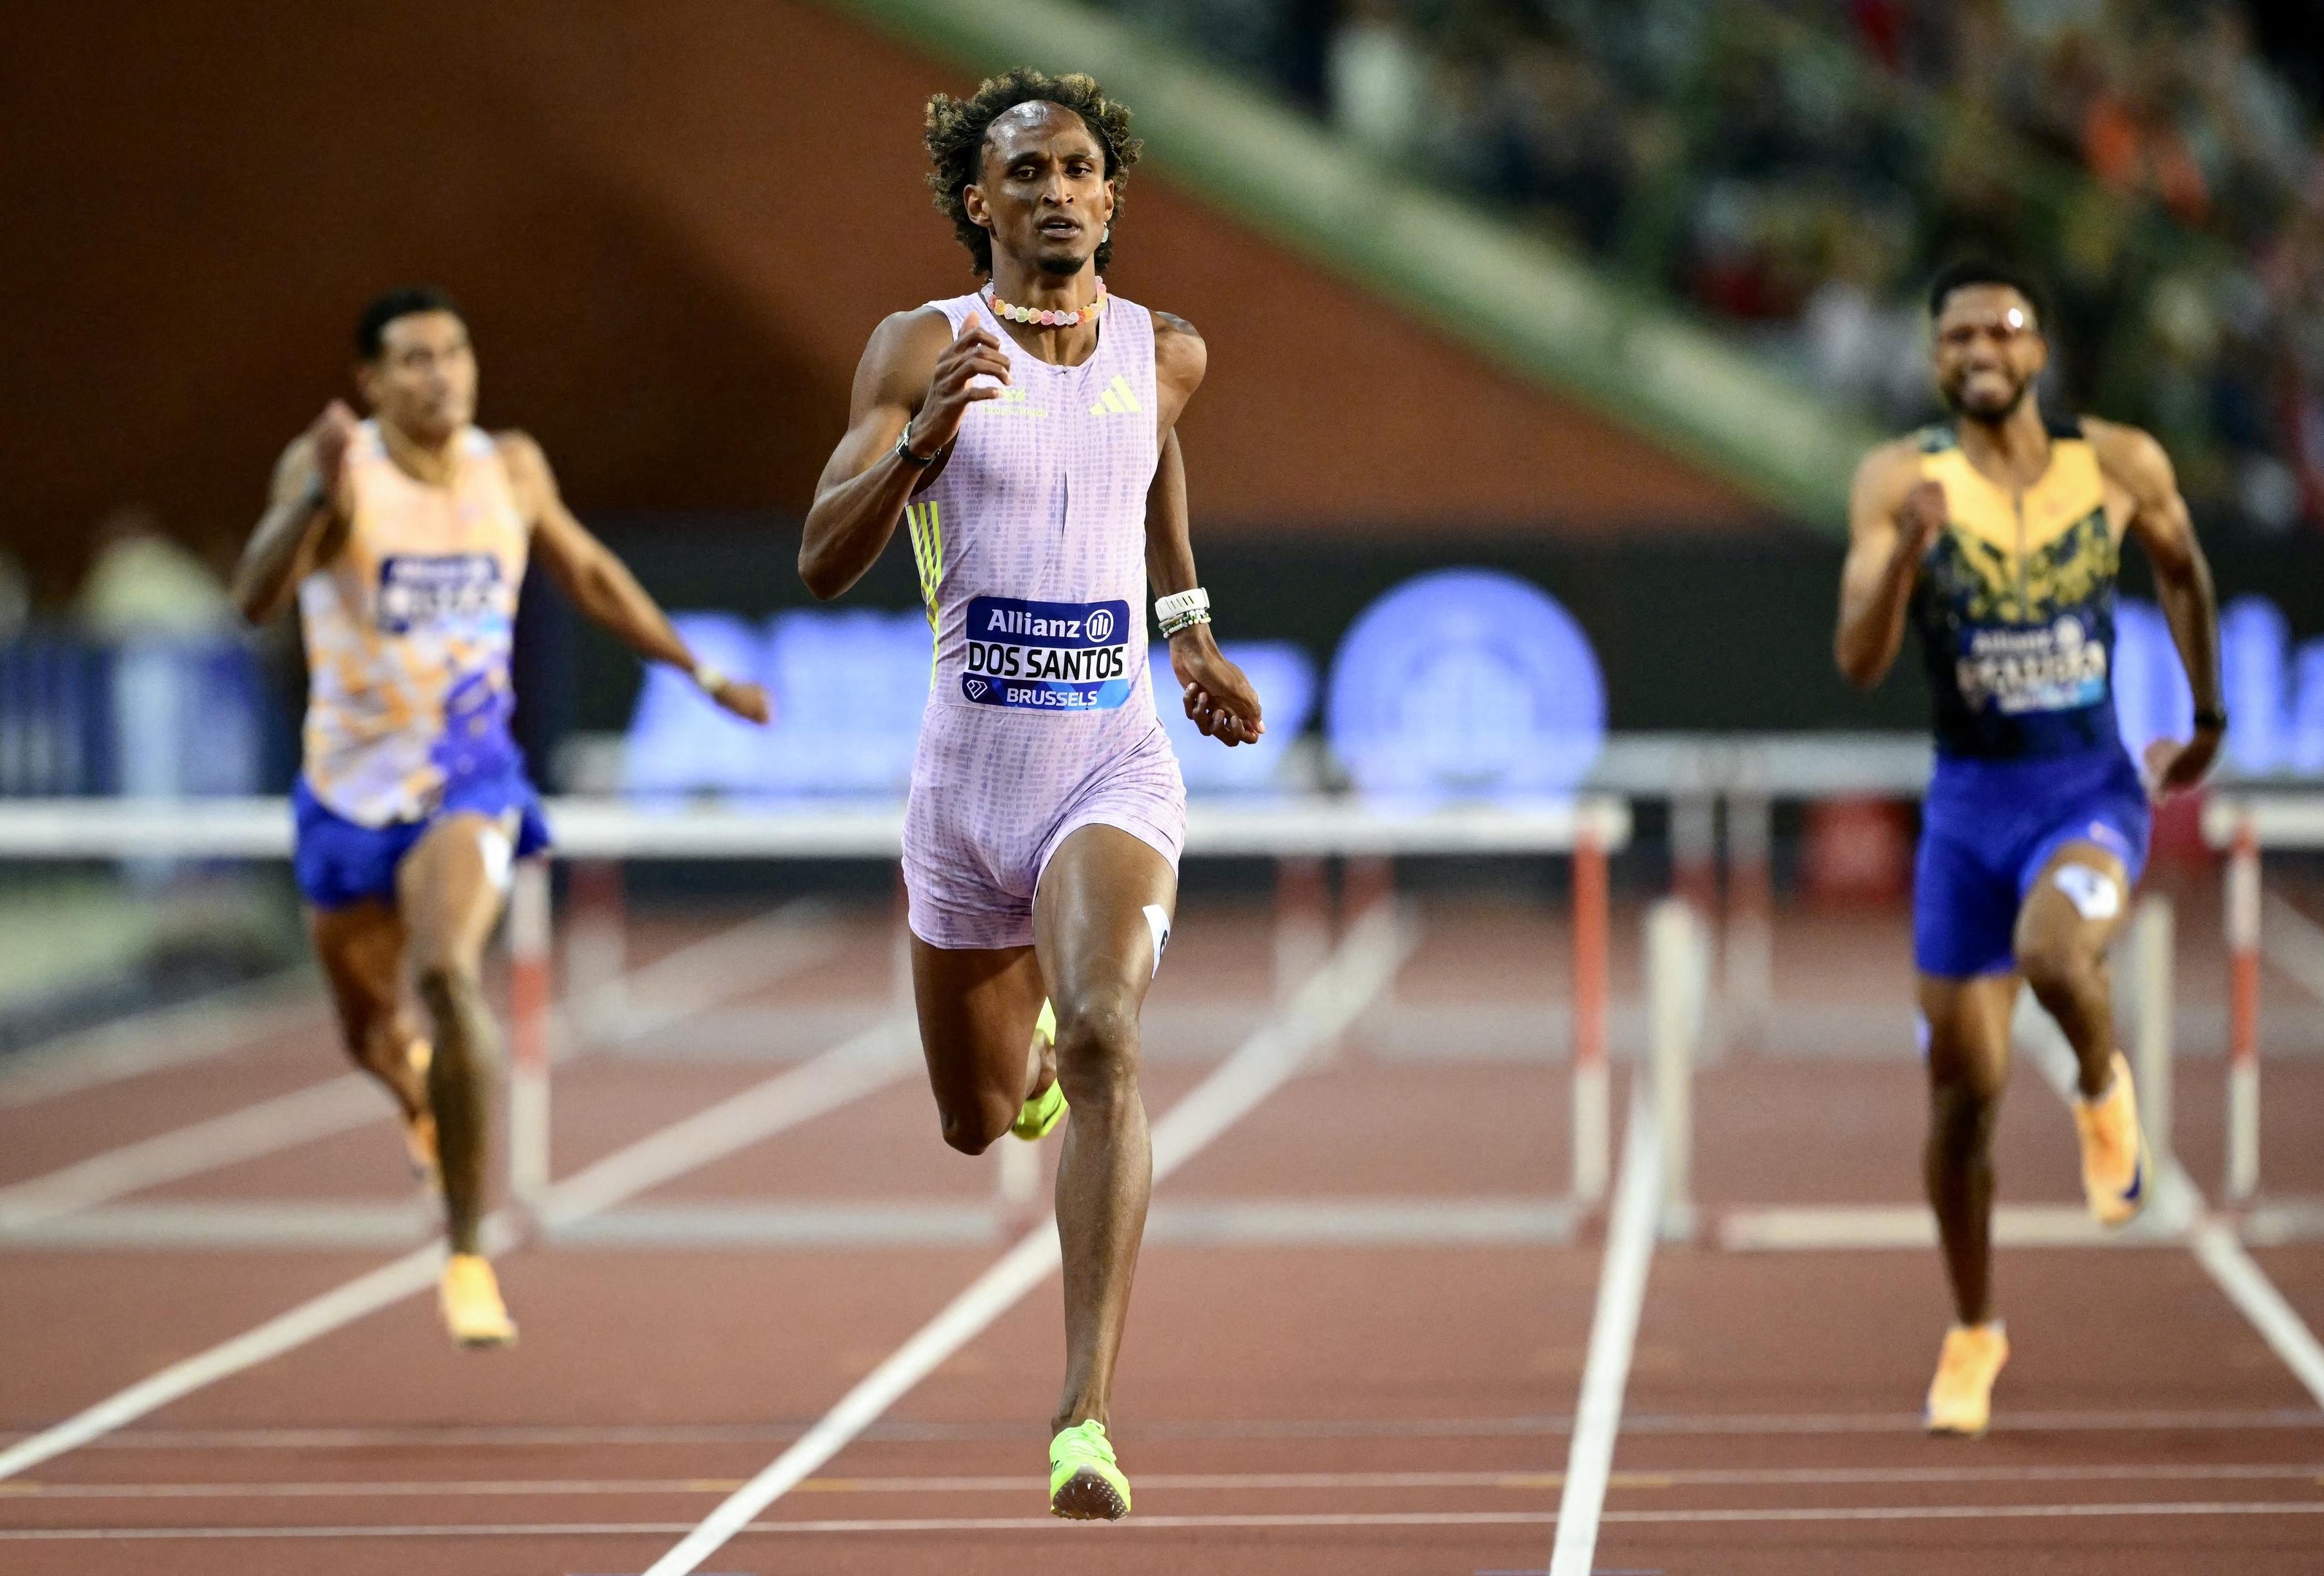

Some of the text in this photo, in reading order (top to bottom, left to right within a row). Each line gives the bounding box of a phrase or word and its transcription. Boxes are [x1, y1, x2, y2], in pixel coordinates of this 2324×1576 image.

[987, 609, 1081, 638] Allianz
[967, 641, 1123, 681] DOS SANTOS
[1006, 687, 1098, 707] BRUSSELS
